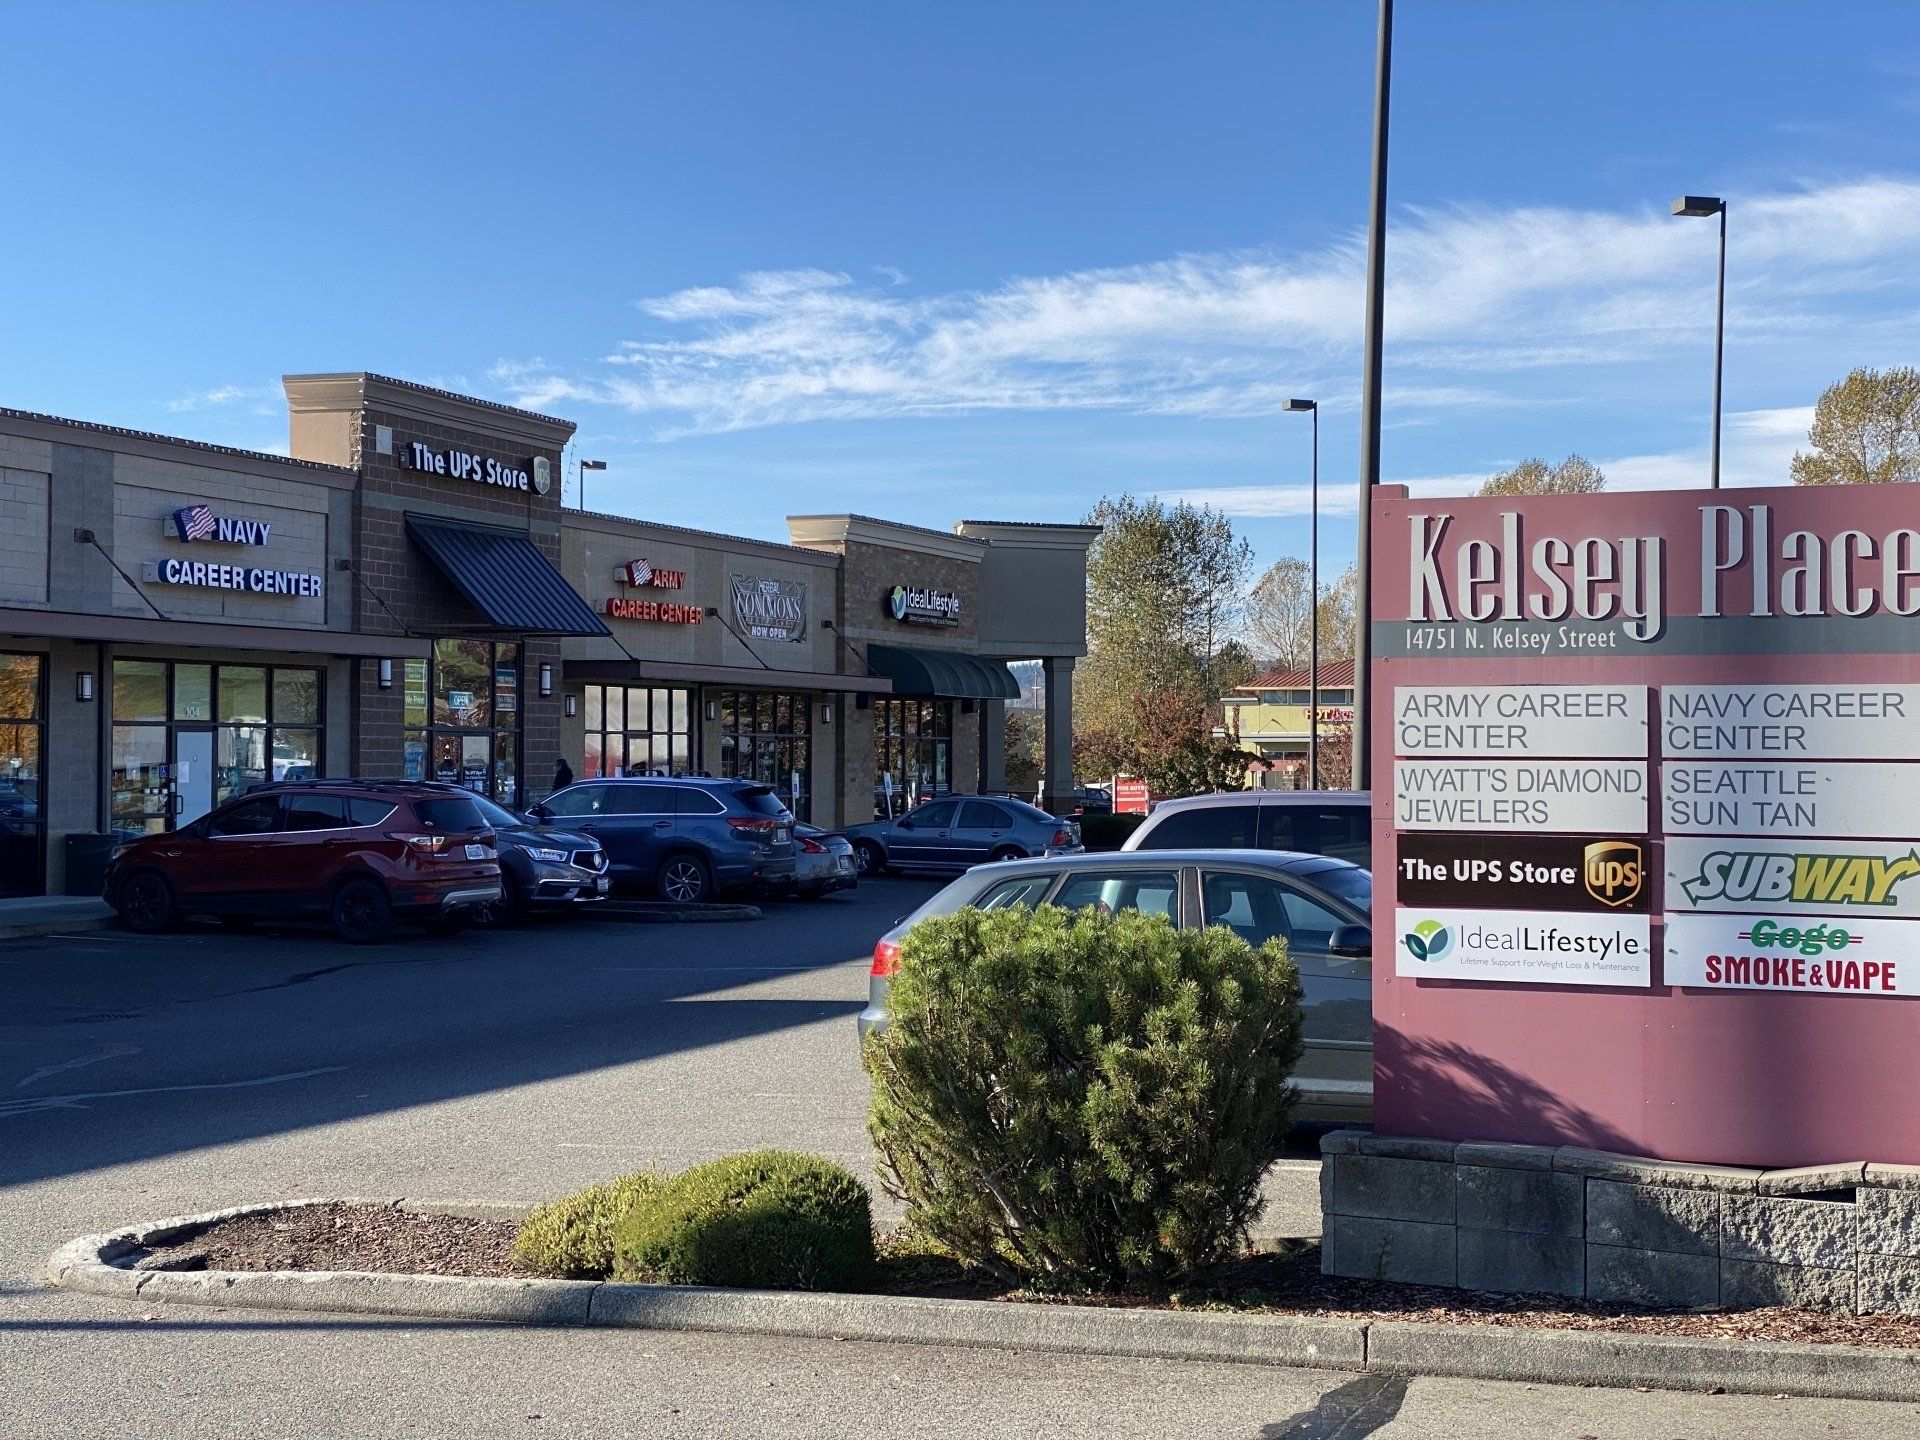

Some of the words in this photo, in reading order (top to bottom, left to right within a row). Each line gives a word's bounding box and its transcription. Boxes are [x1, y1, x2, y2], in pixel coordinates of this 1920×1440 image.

[413, 442, 446, 474] The
[450, 450, 482, 482] UPS
[486, 458, 528, 491] Store
[219, 517, 271, 546] NAVY
[165, 559, 245, 590] CAREER
[250, 568, 322, 597] CENTER
[653, 569, 686, 590] ARMY
[1406, 512, 1661, 641] Kelsey
[1697, 505, 1920, 617] Place
[612, 598, 658, 621] CAREER
[661, 602, 703, 625] CENTER
[751, 625, 768, 637] NOW
[769, 627, 787, 639] OPEN
[1406, 628, 1455, 650] 14751
[1465, 627, 1484, 649] N.
[1493, 627, 1551, 654] Kelsey
[1558, 626, 1616, 648] Street
[186, 706, 200, 718] 104
[1402, 694, 1490, 718] ARMY
[1497, 693, 1629, 718] CAREER
[1669, 693, 1756, 718] NAVY
[1763, 692, 1906, 718] CAREER
[1401, 725, 1529, 749] CENTER
[1668, 725, 1807, 750] CENTER
[1401, 768, 1508, 792] WYATT'S
[1517, 769, 1642, 793] DIAMOND
[1670, 769, 1817, 795] SEATTLE
[1401, 799, 1549, 824] JEWELERS
[1670, 801, 1739, 826] SUN
[1752, 802, 1816, 827] TAN
[1402, 858, 1447, 881] The
[1453, 859, 1503, 883] UPS
[1588, 860, 1638, 896] ups
[1691, 850, 1905, 906] SUBWAY
[1750, 919, 1850, 956] Gogo
[1460, 958, 1489, 966] Lifetime
[1491, 958, 1521, 969] Support
[1523, 959, 1535, 967] For
[1536, 959, 1564, 970] Weight
[1565, 961, 1582, 970] Loss
[1583, 962, 1590, 970] &
[1592, 962, 1640, 972] Maintenance
